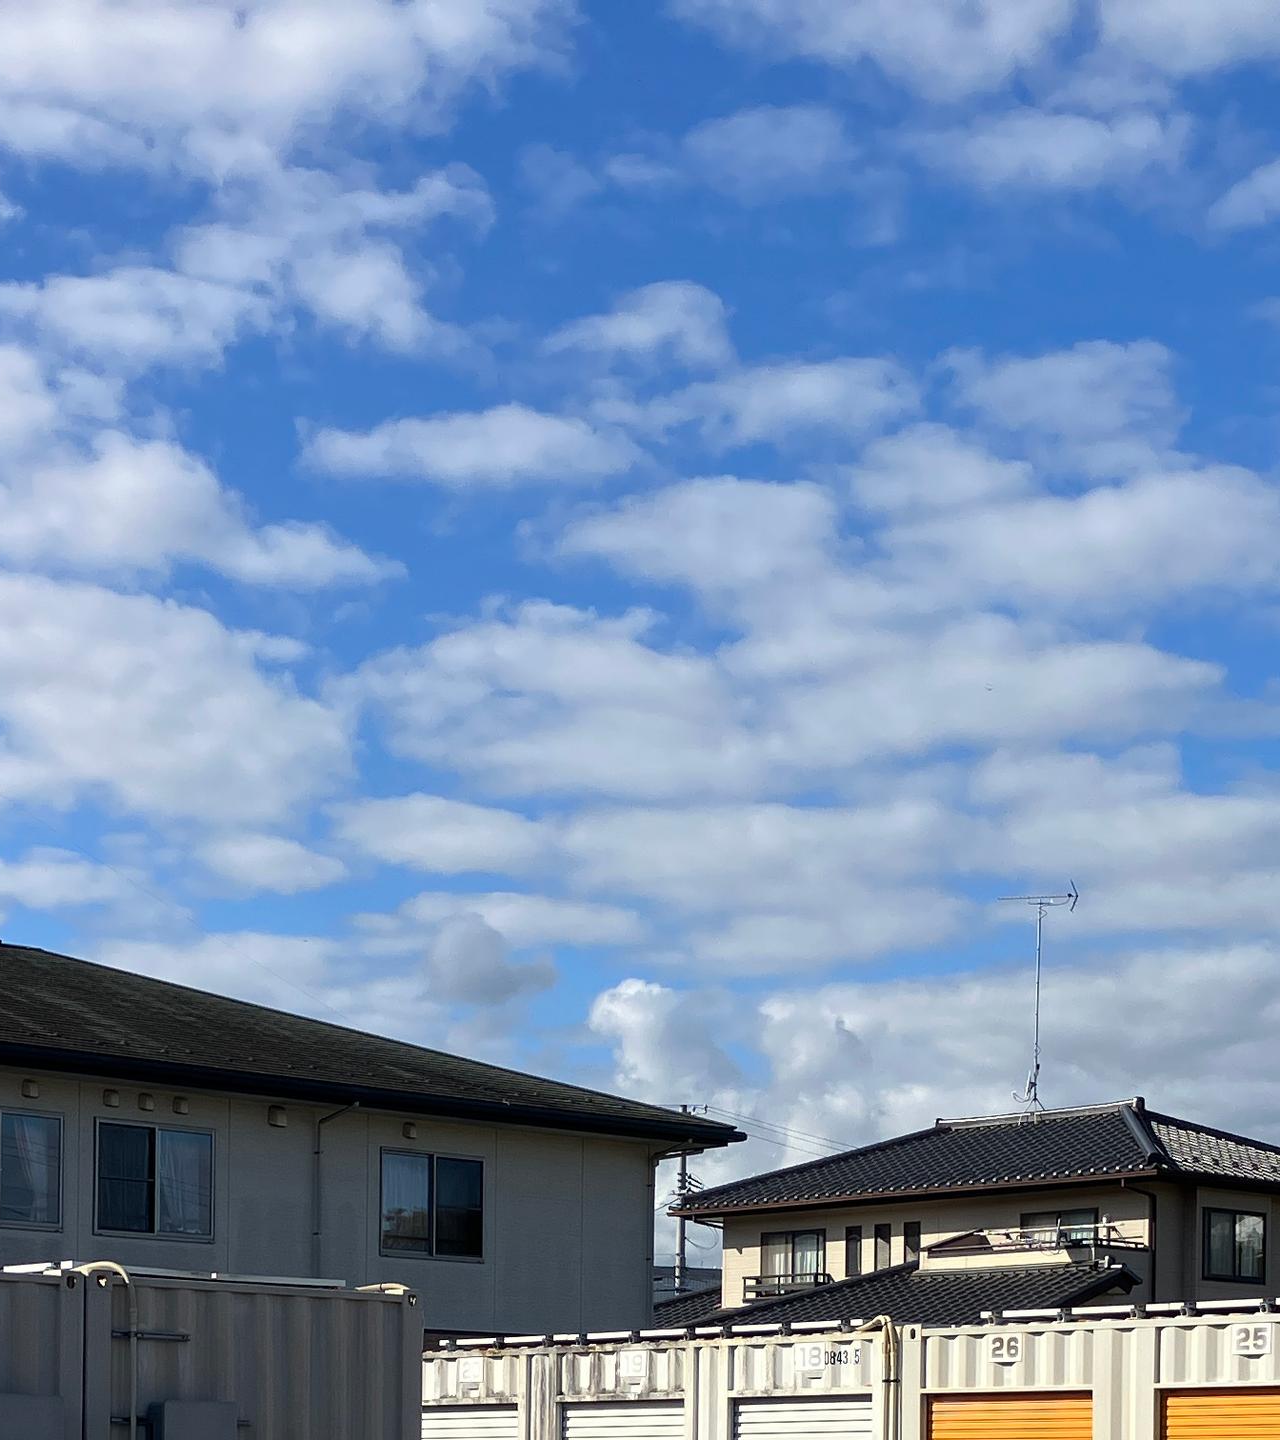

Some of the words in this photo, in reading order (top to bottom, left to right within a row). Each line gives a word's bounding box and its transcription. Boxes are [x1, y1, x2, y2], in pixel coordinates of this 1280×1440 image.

[990, 1336, 1019, 1359] 26
[1236, 1327, 1269, 1352] 25
[624, 1353, 643, 1374] 19
[799, 1346, 822, 1367] 18
